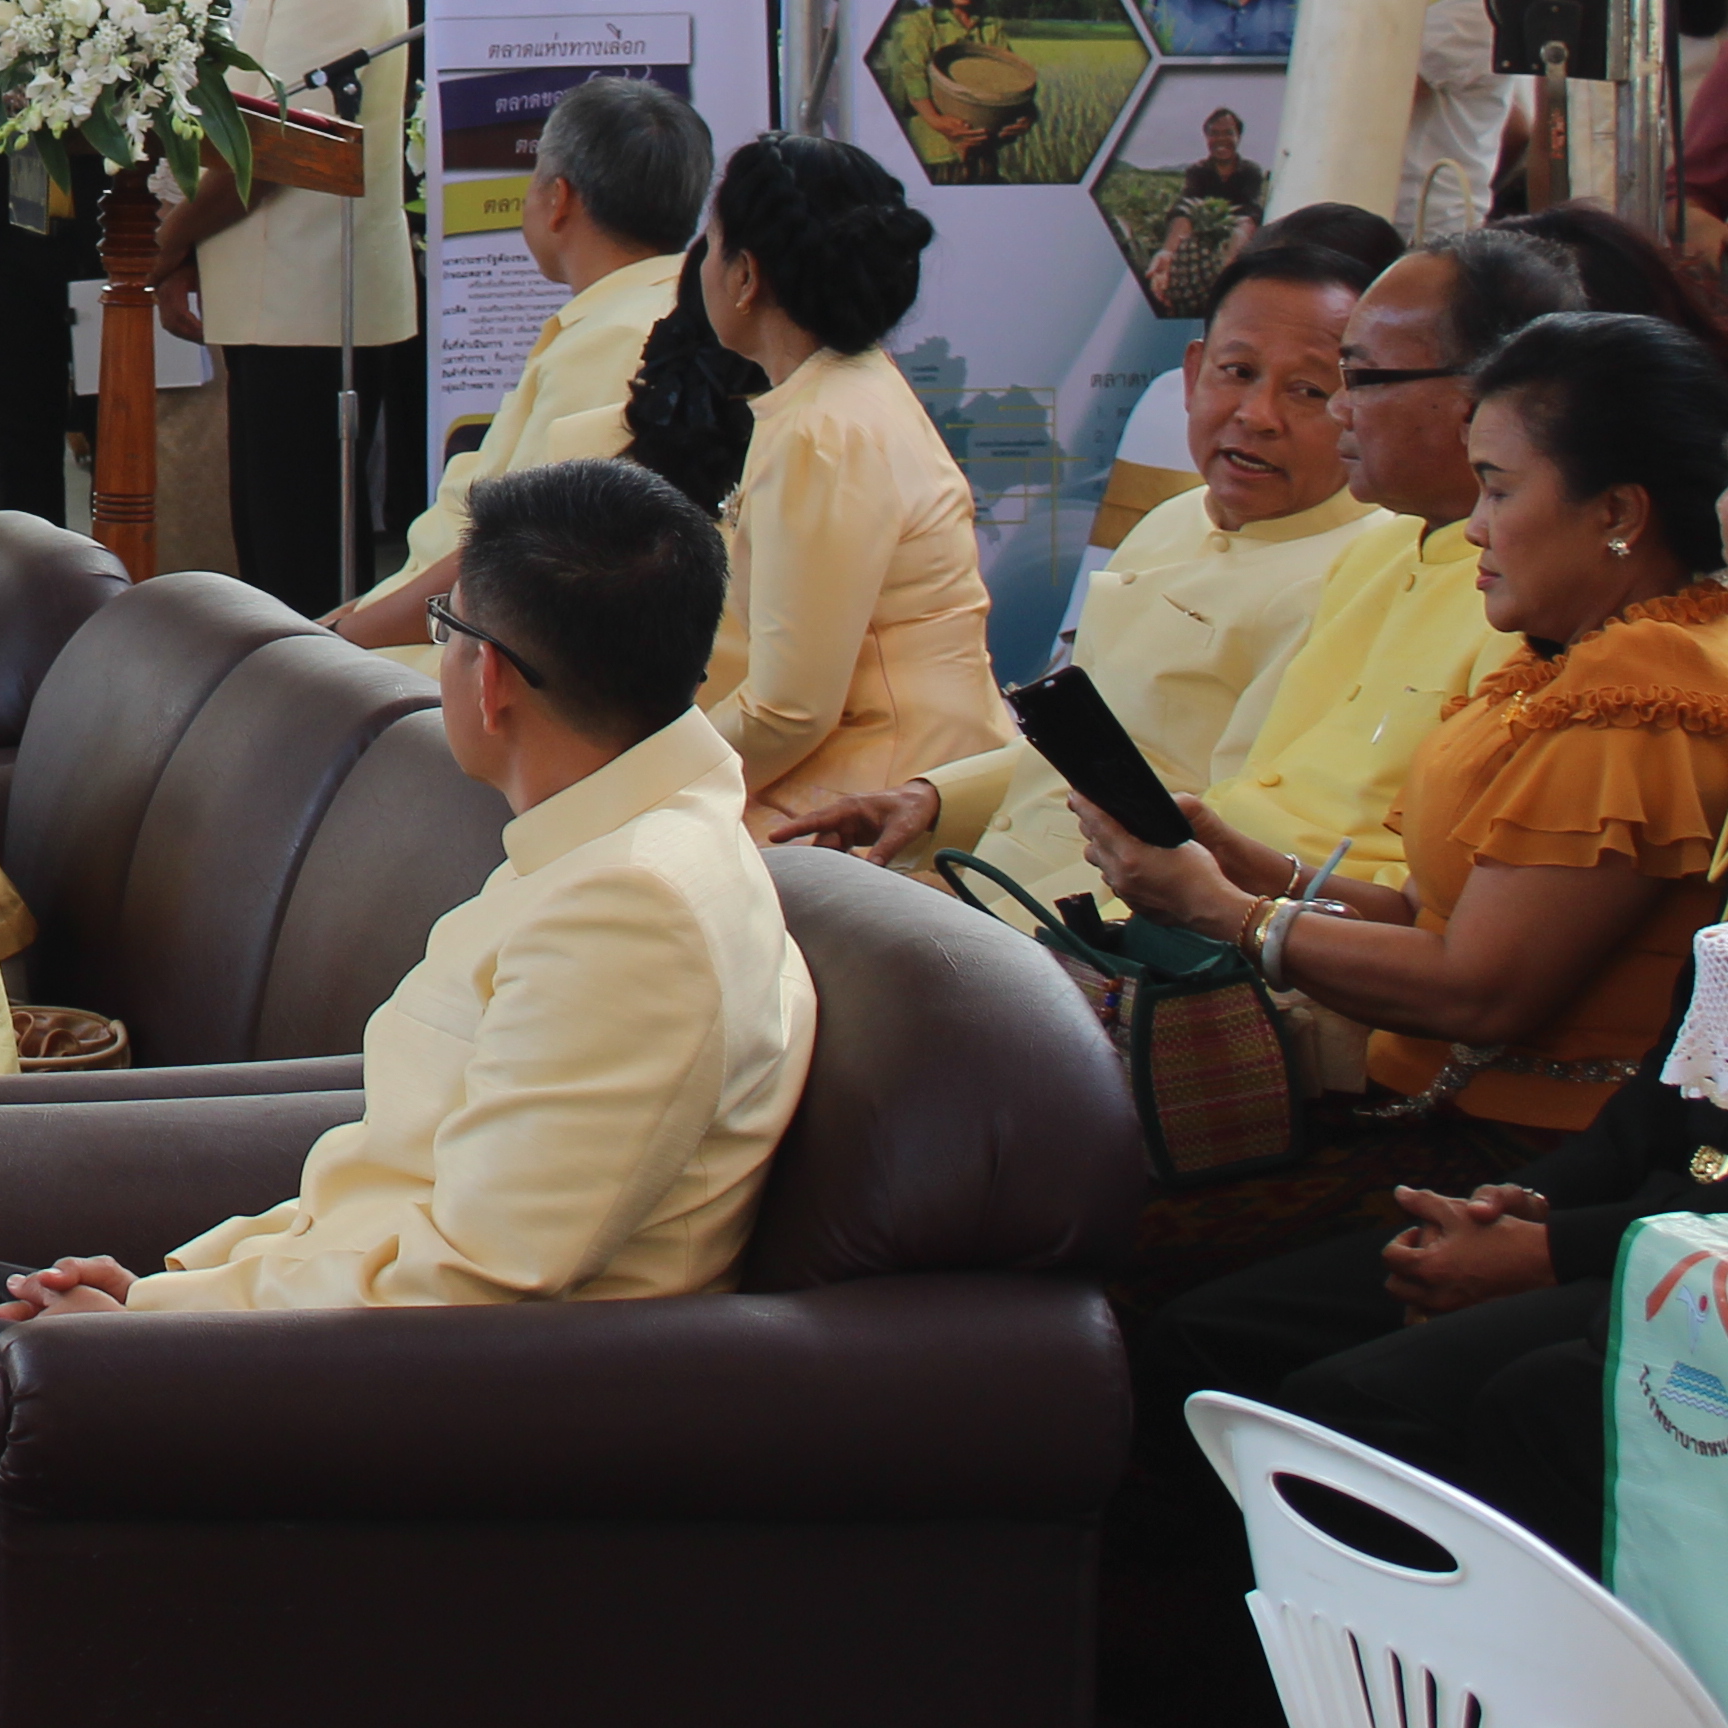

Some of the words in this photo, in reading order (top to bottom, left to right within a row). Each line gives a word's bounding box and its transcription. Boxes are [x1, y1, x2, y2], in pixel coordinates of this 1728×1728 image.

[487, 23, 645, 60] ตลาดแห่งทางเลือก
